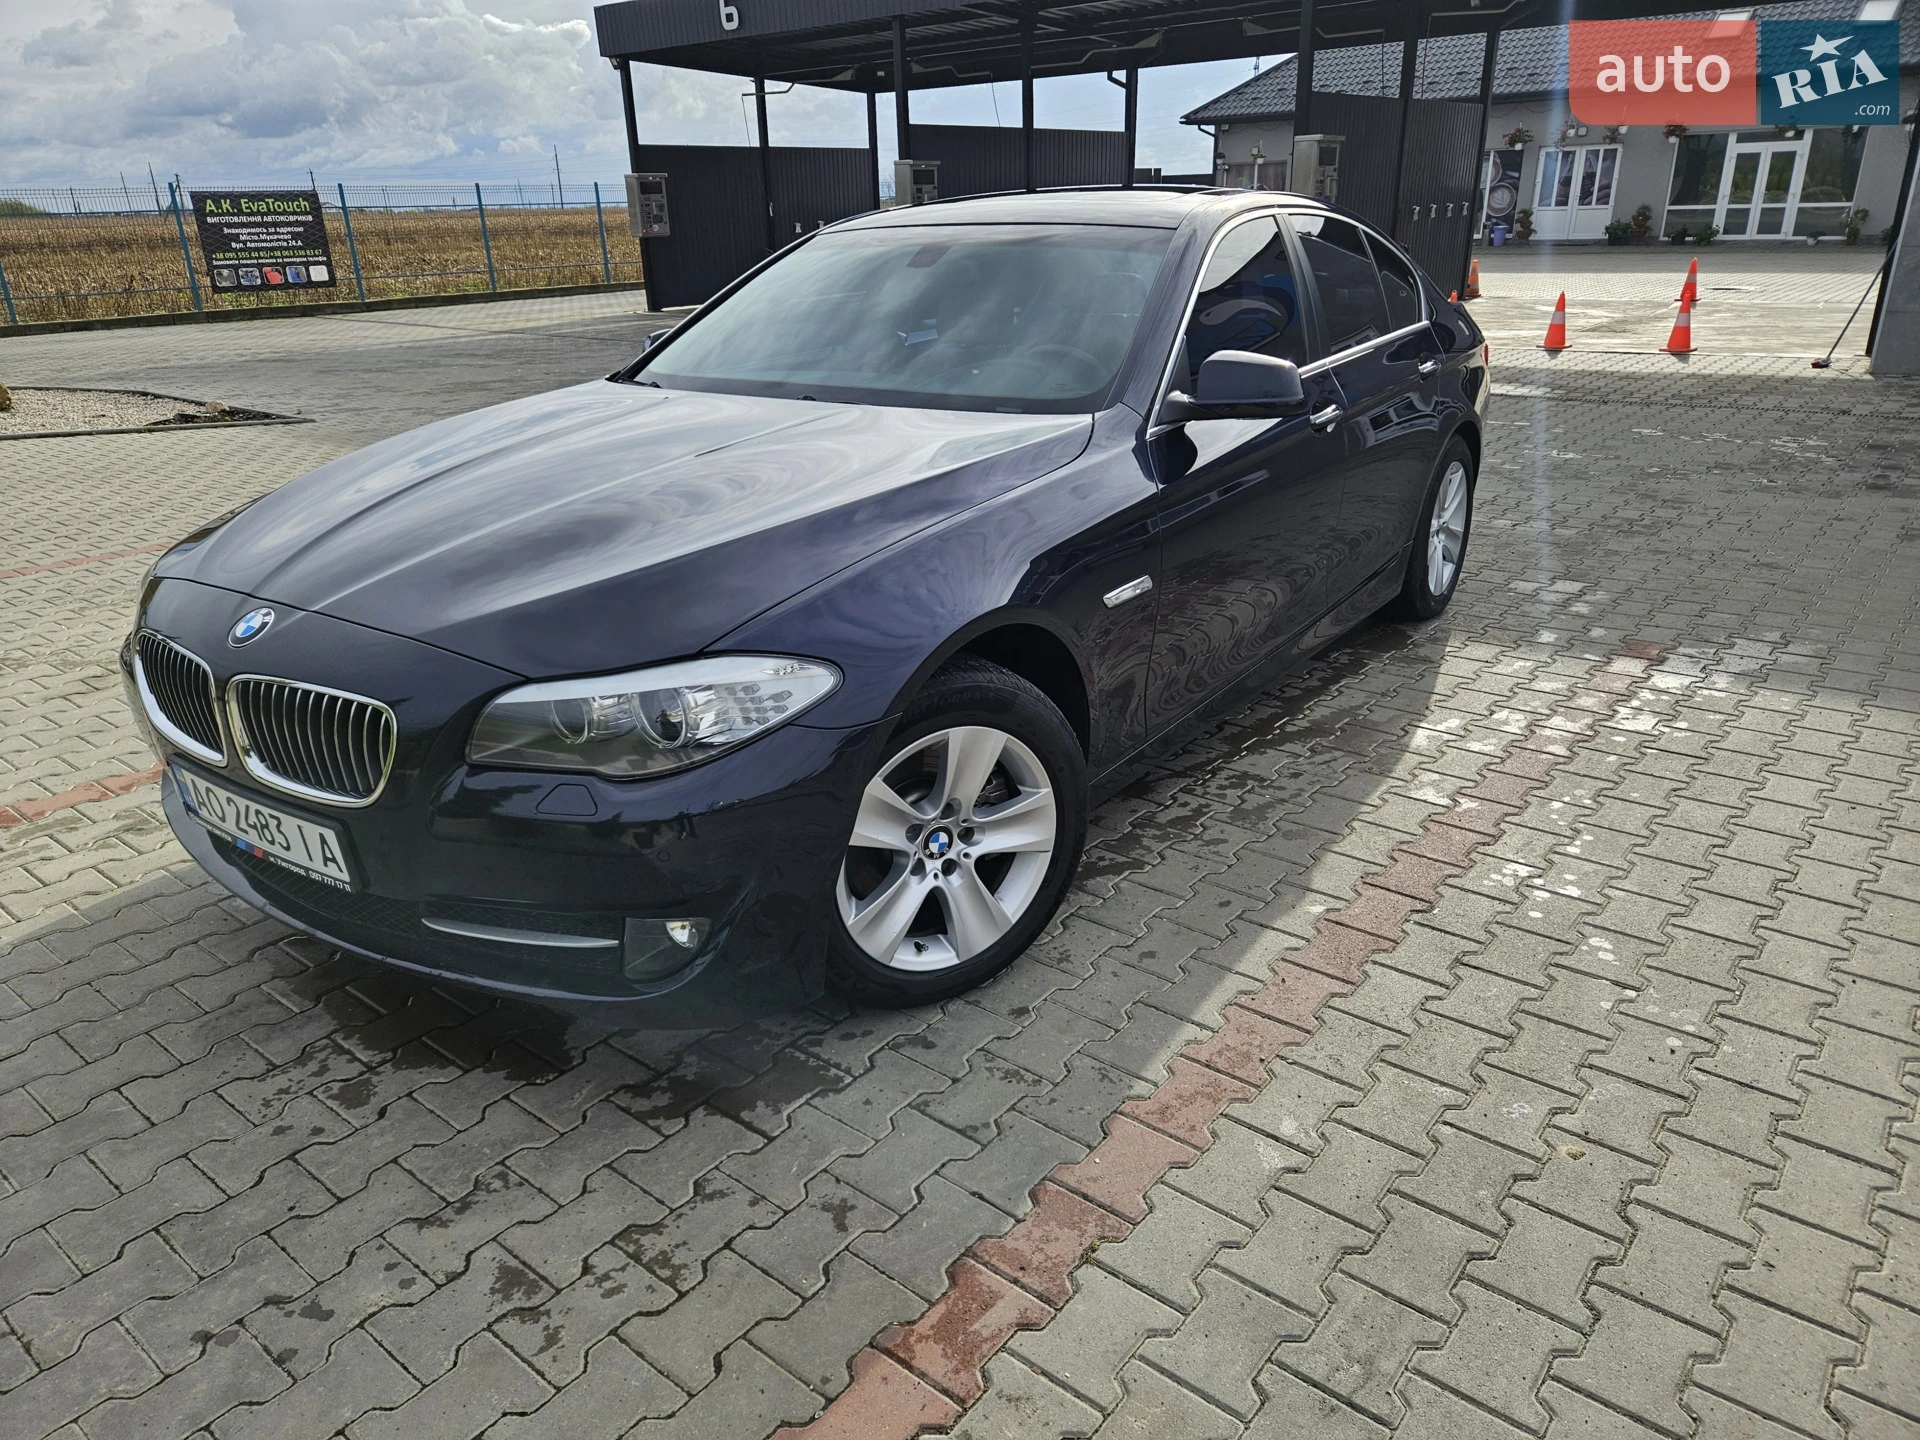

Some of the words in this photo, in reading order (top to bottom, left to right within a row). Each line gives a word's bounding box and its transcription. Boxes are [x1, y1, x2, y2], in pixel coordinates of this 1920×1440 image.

[240, 197, 310, 213] EvaTouch
[206, 215, 262, 224] ВИГОТОВЛЕННЯ
[263, 214, 313, 223] АВТОКОВРИКІВ
[190, 778, 227, 824] AO
[226, 796, 291, 852] 2483
[297, 823, 344, 874] IA
